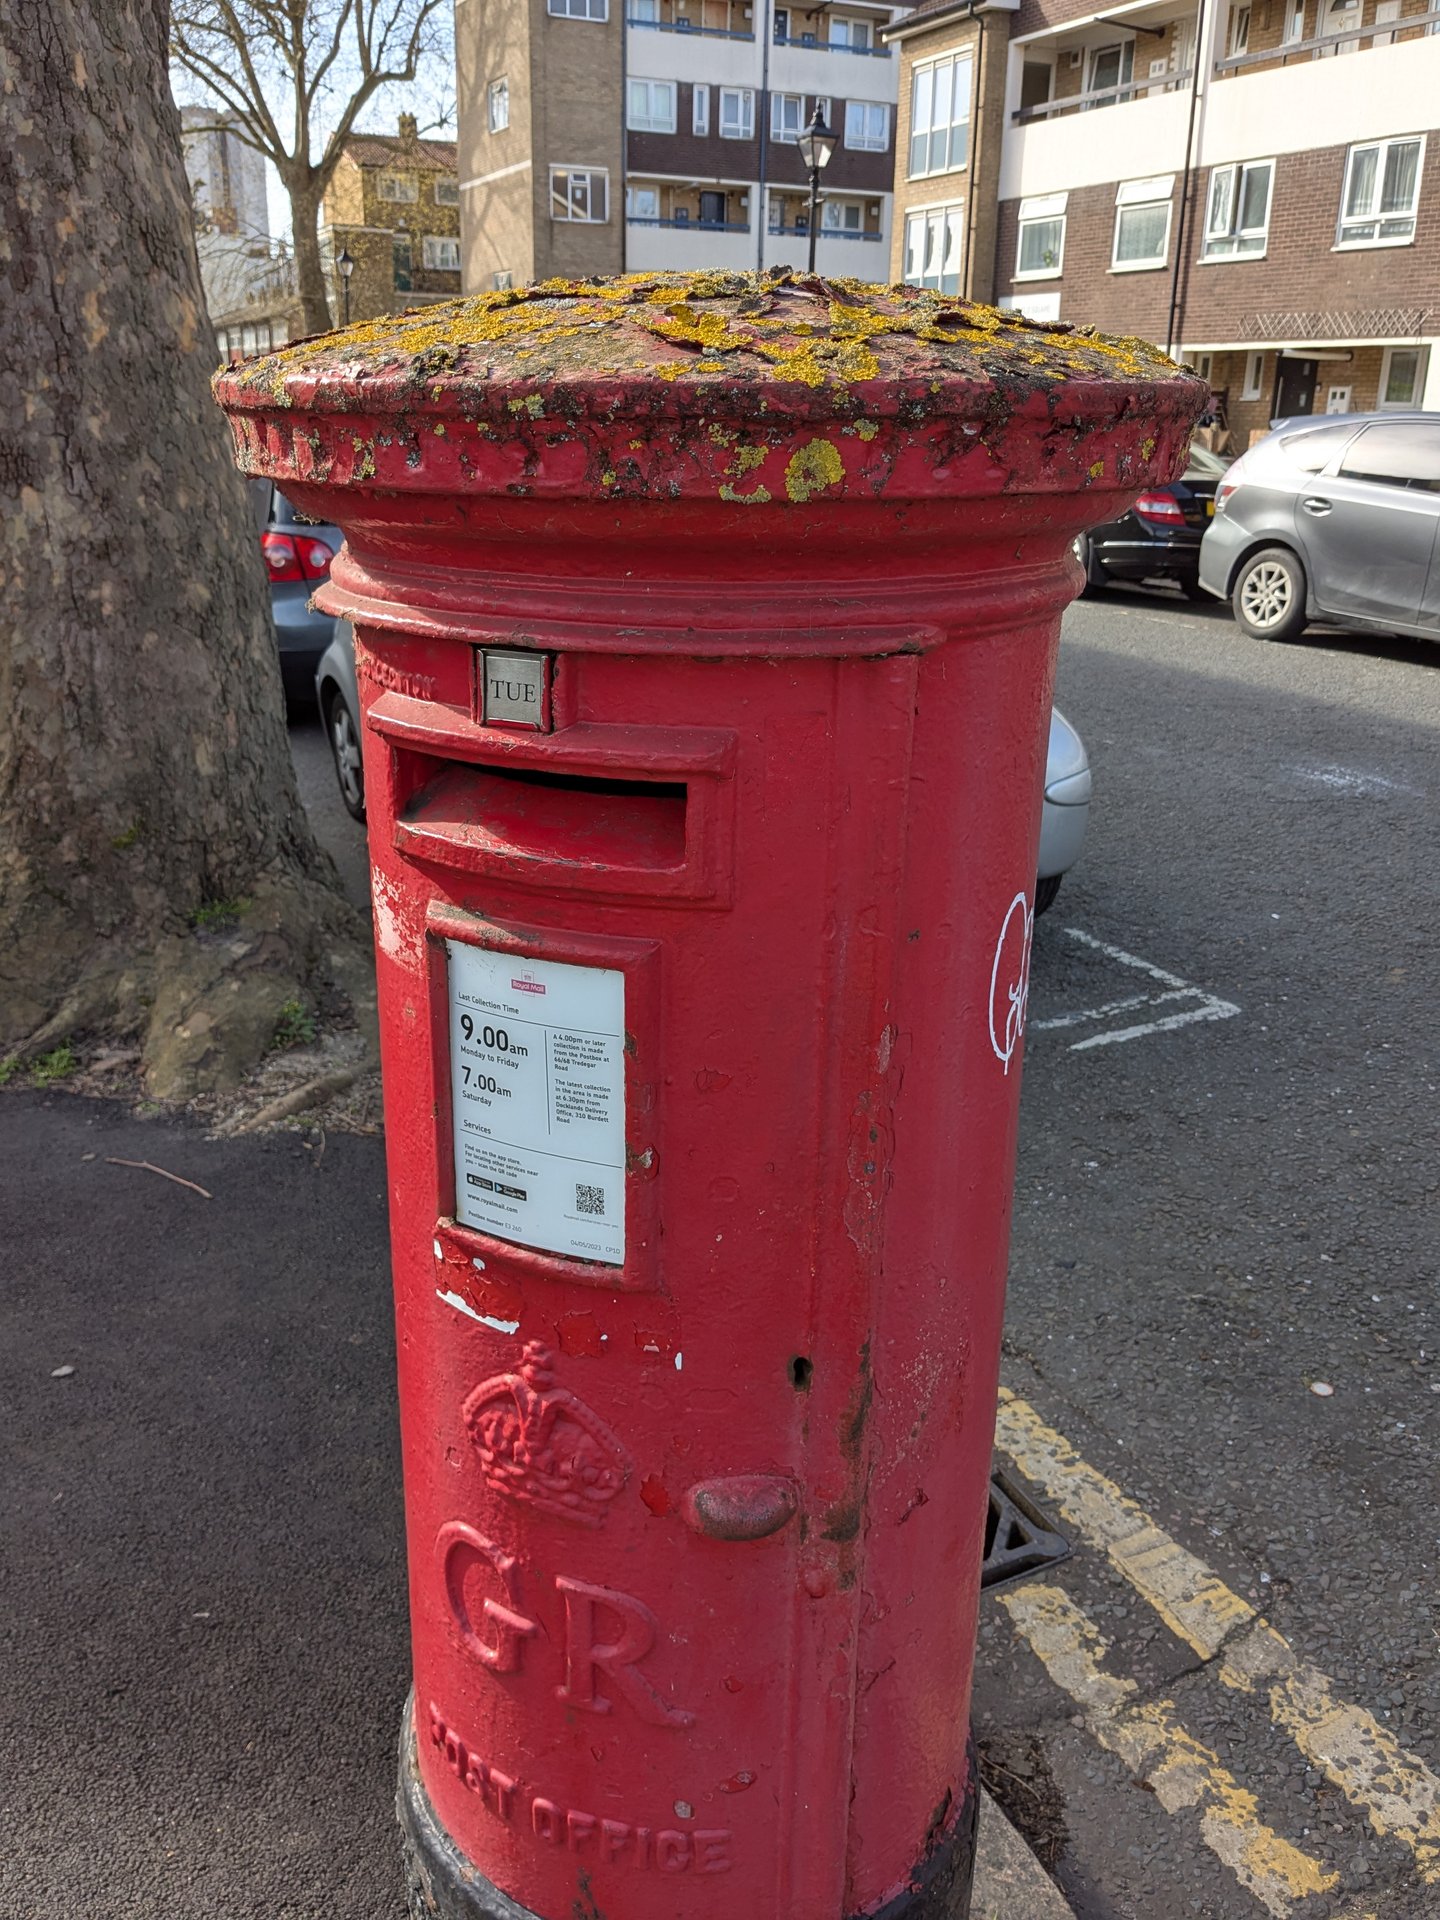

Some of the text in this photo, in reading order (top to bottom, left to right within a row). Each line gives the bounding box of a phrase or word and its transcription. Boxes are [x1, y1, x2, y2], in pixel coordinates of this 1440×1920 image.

[490, 679, 536, 703] TUE
[512, 980, 545, 993] Royal Mail
[458, 991, 520, 1015] Last Collection Time
[460, 1013, 528, 1057] 9.00am
[558, 1034, 583, 1044] 4.00pm
[553, 1042, 580, 1051] collection
[460, 1045, 520, 1070] Monday to Friday
[572, 1059, 597, 1069] Tredegar
[579, 1053, 602, 1062] Postbox
[554, 1064, 569, 1072] Road
[461, 1065, 512, 1098] 7.00am
[554, 1078, 612, 1093] The latest collection
[462, 1089, 492, 1107] Saturday
[586, 1099, 601, 1107] from
[592, 1093, 609, 1101] made
[555, 1101, 609, 1117] Docklands Delivery
[575, 1111, 587, 1120] 310
[463, 1119, 492, 1134] Services
[556, 1115, 571, 1124] Road
[464, 1143, 475, 1151] Find
[492, 1159, 505, 1168] other
[505, 1163, 526, 1174] services
[468, 1209, 486, 1221] Postbox
[486, 1216, 504, 1227] number
[430, 1700, 733, 1874] POST OFFICE
